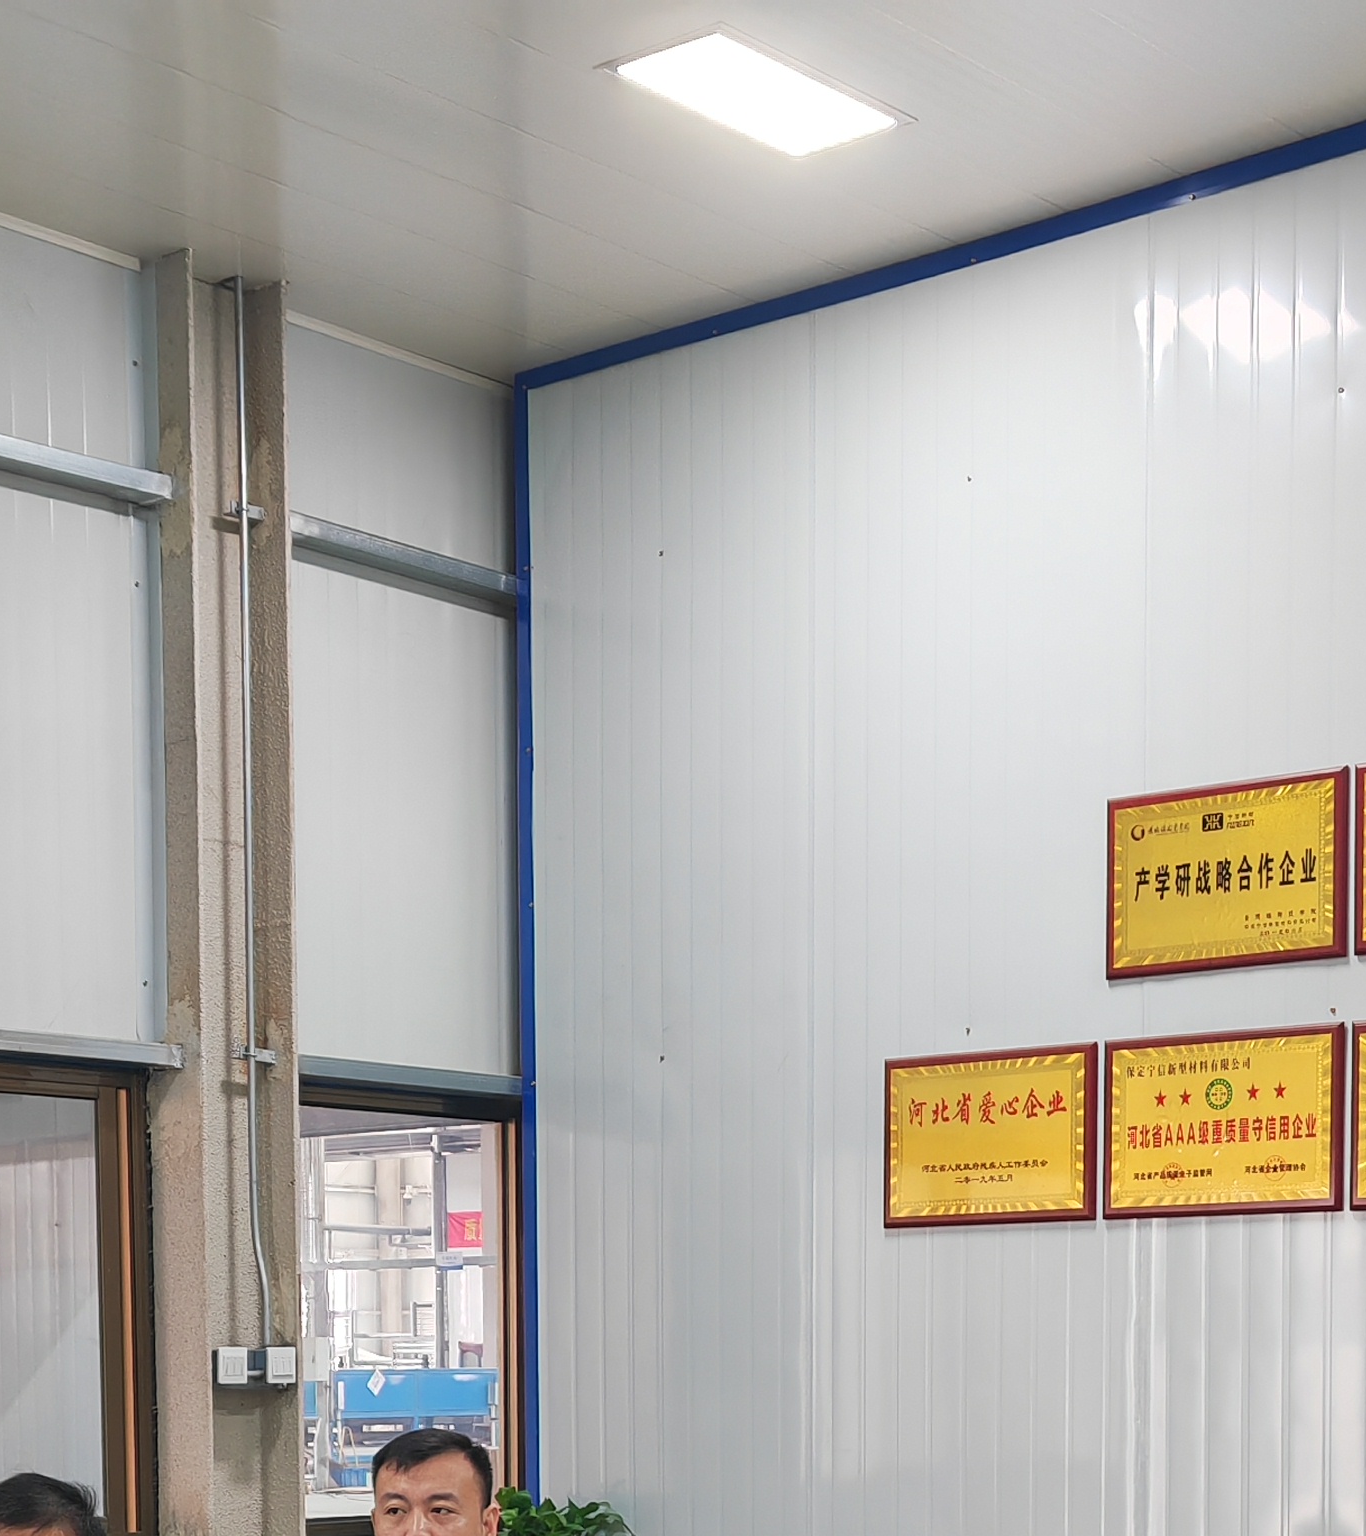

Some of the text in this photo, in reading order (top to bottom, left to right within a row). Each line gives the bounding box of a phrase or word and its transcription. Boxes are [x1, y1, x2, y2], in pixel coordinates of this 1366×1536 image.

[1134, 847, 1318, 903] 产学研战略合作企业
[1126, 1056, 1251, 1079] 保定宁信新型材料有限公司
[908, 1087, 1069, 1127] 河北省爱心企业
[1126, 1112, 1317, 1151] 河北省AAA级重质量守信用企业
